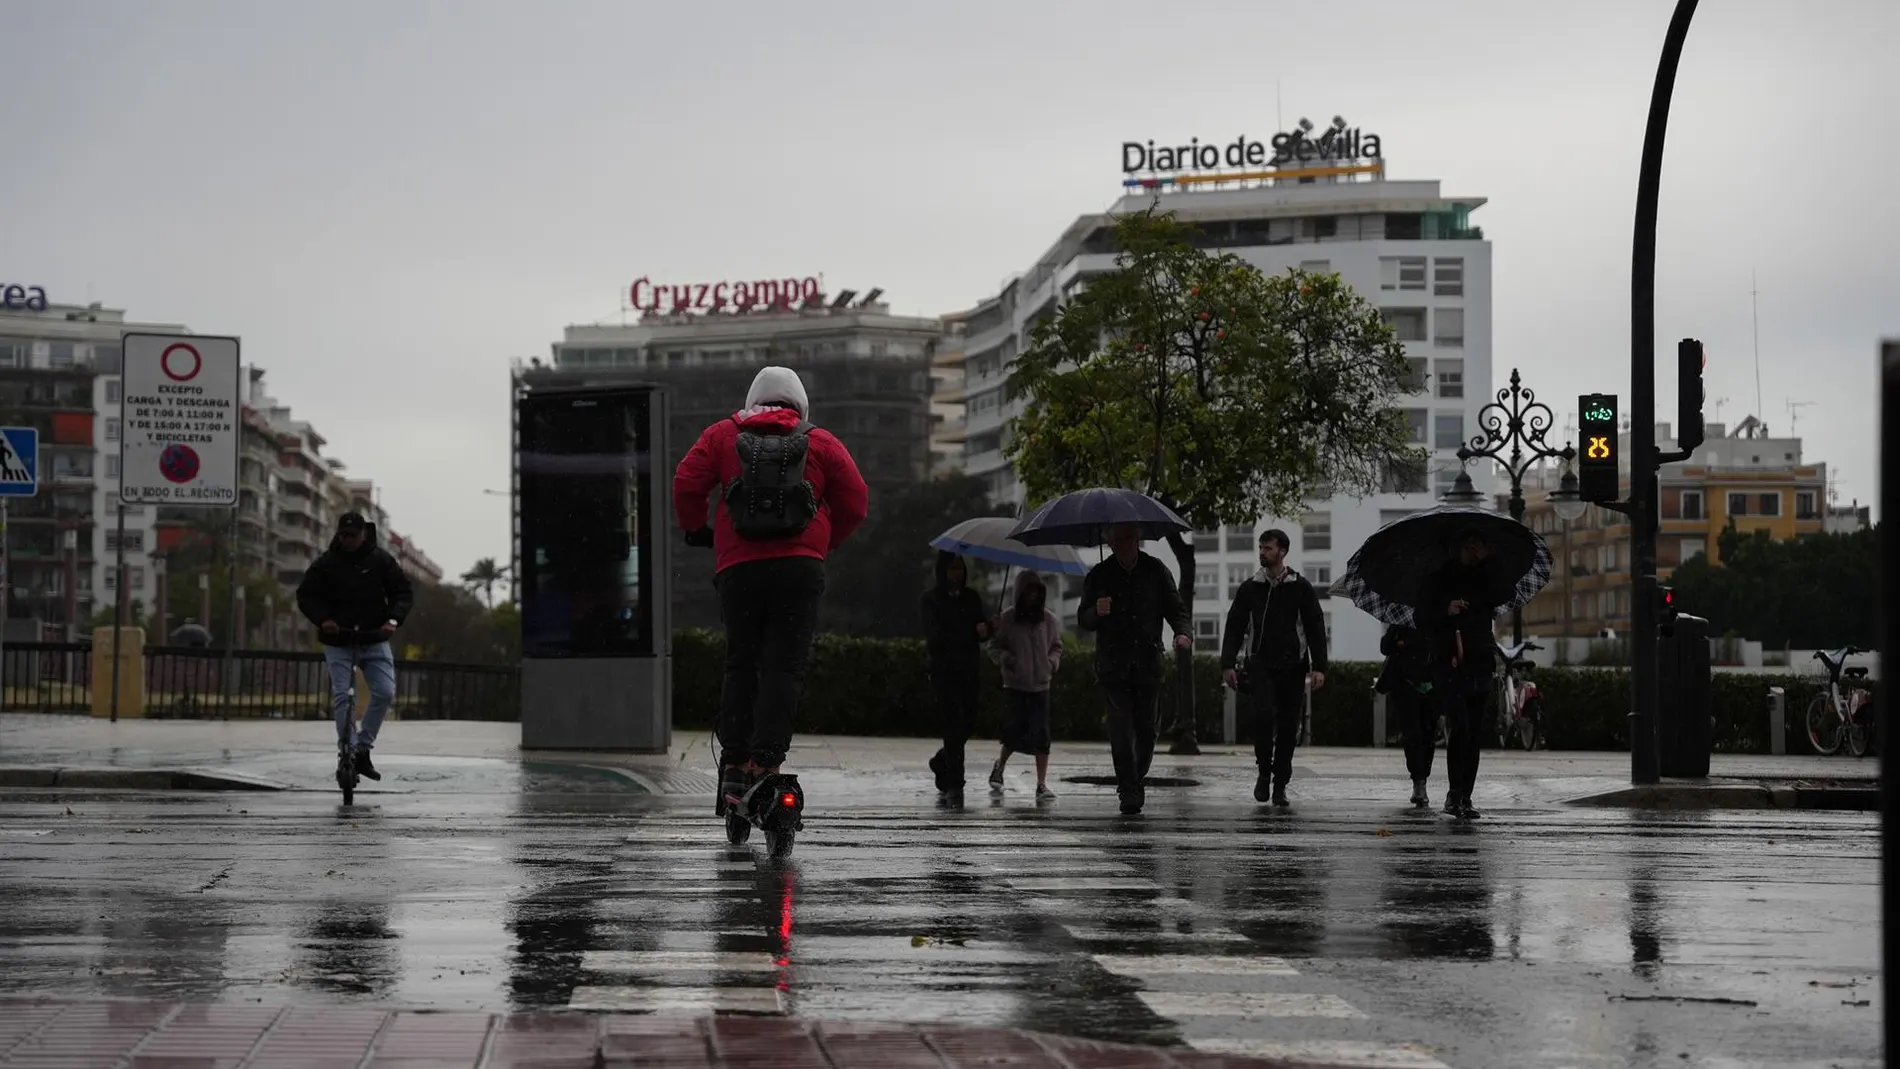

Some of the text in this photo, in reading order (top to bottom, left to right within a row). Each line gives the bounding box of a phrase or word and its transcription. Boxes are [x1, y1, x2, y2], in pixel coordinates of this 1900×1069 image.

[1122, 127, 1382, 174] Diario de Sevilla
[630, 274, 820, 310] Cruzcampo
[158, 385, 203, 394] EXCEPTO
[127, 396, 231, 408] CARGA Y DESCARGA
[136, 408, 224, 420] DE 7:00 A 11:00 H
[128, 420, 231, 432] Y DE 15:00 A 17:00 H
[146, 433, 213, 443] Y BICICLETAS
[1588, 437, 1610, 458] 25
[124, 487, 137, 496] EN
[174, 487, 186, 498] EL
[191, 488, 233, 498] RECINTO
